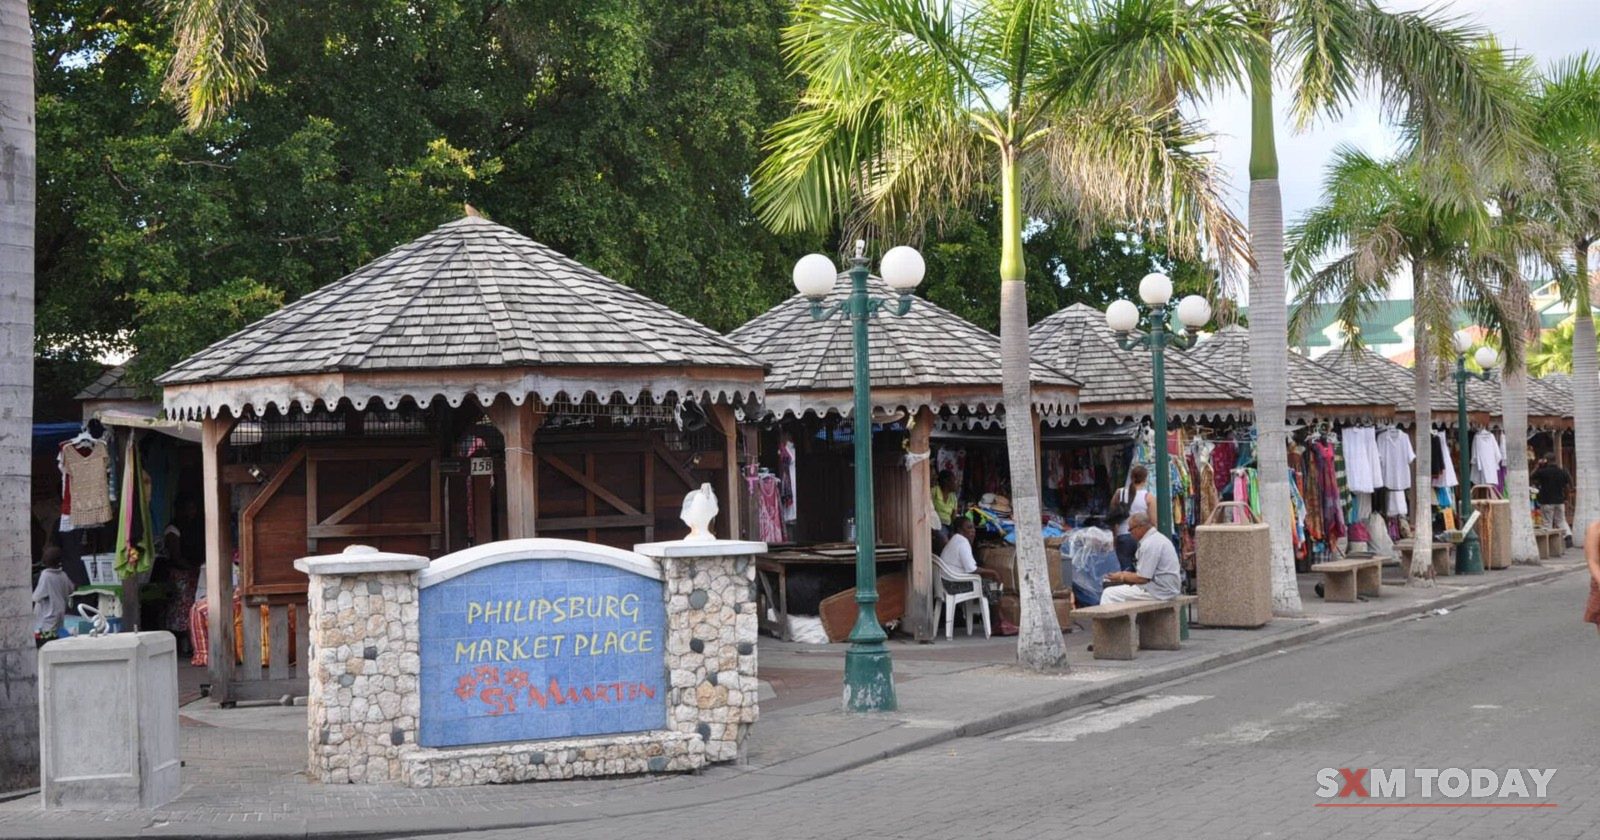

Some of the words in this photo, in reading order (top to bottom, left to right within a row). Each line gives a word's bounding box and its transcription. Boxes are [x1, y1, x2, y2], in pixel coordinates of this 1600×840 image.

[467, 594, 640, 624] PHILIPSBURG
[455, 635, 565, 664] MARKET
[574, 630, 655, 657] PLACE
